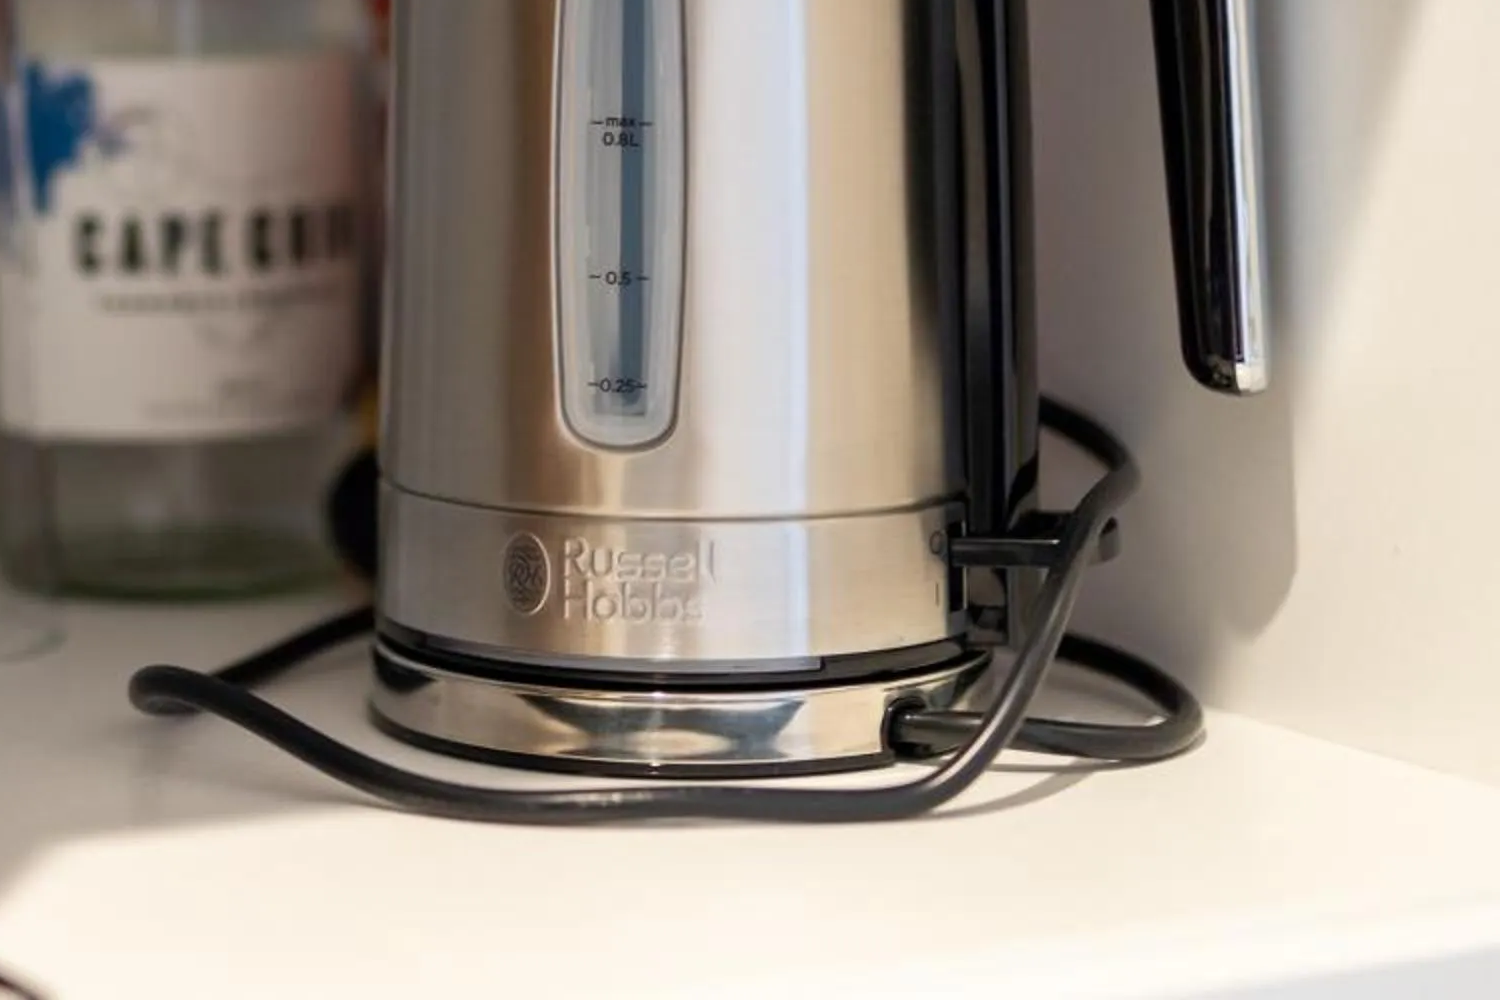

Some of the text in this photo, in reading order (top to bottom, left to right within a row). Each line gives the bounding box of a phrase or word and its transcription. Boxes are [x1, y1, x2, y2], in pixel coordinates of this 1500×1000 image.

[605, 116, 636, 128] max
[603, 131, 639, 147] 0.8L
[74, 207, 229, 280] CAPE
[605, 271, 632, 286] 0.5
[600, 377, 636, 393] 0.25
[563, 536, 717, 584] Russell
[563, 577, 706, 624] Hobbs
